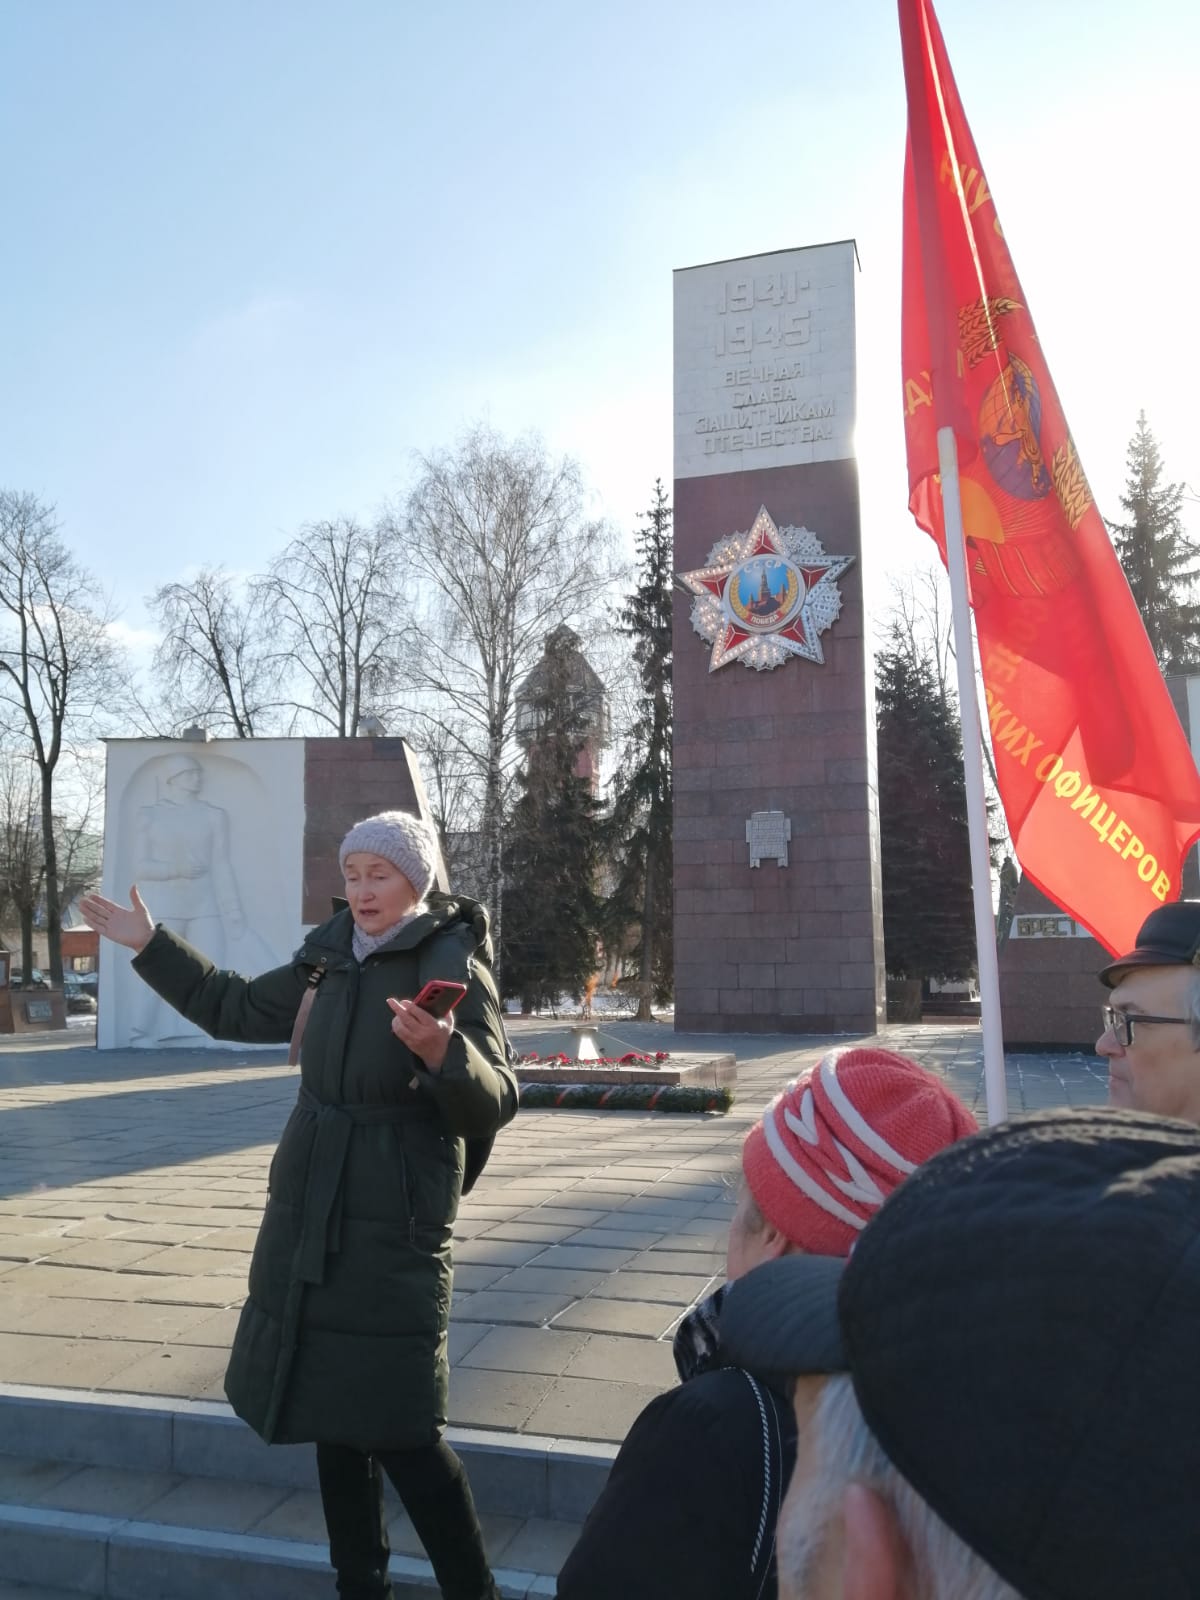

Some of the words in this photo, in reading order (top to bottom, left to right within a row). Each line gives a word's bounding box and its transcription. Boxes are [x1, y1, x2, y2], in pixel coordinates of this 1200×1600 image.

[715, 310, 811, 357] 1945
[723, 362, 804, 387] ВЕЧНАЯ
[732, 385, 797, 410] СЛАВА
[694, 401, 835, 434] ЗАЩИТНИКАМ
[743, 559, 782, 573] СССР
[751, 614, 779, 625] ПОБЕДА
[1035, 752, 1172, 902] ОФИЦЕРОВ
[1017, 917, 1078, 937] БРЕСТ
